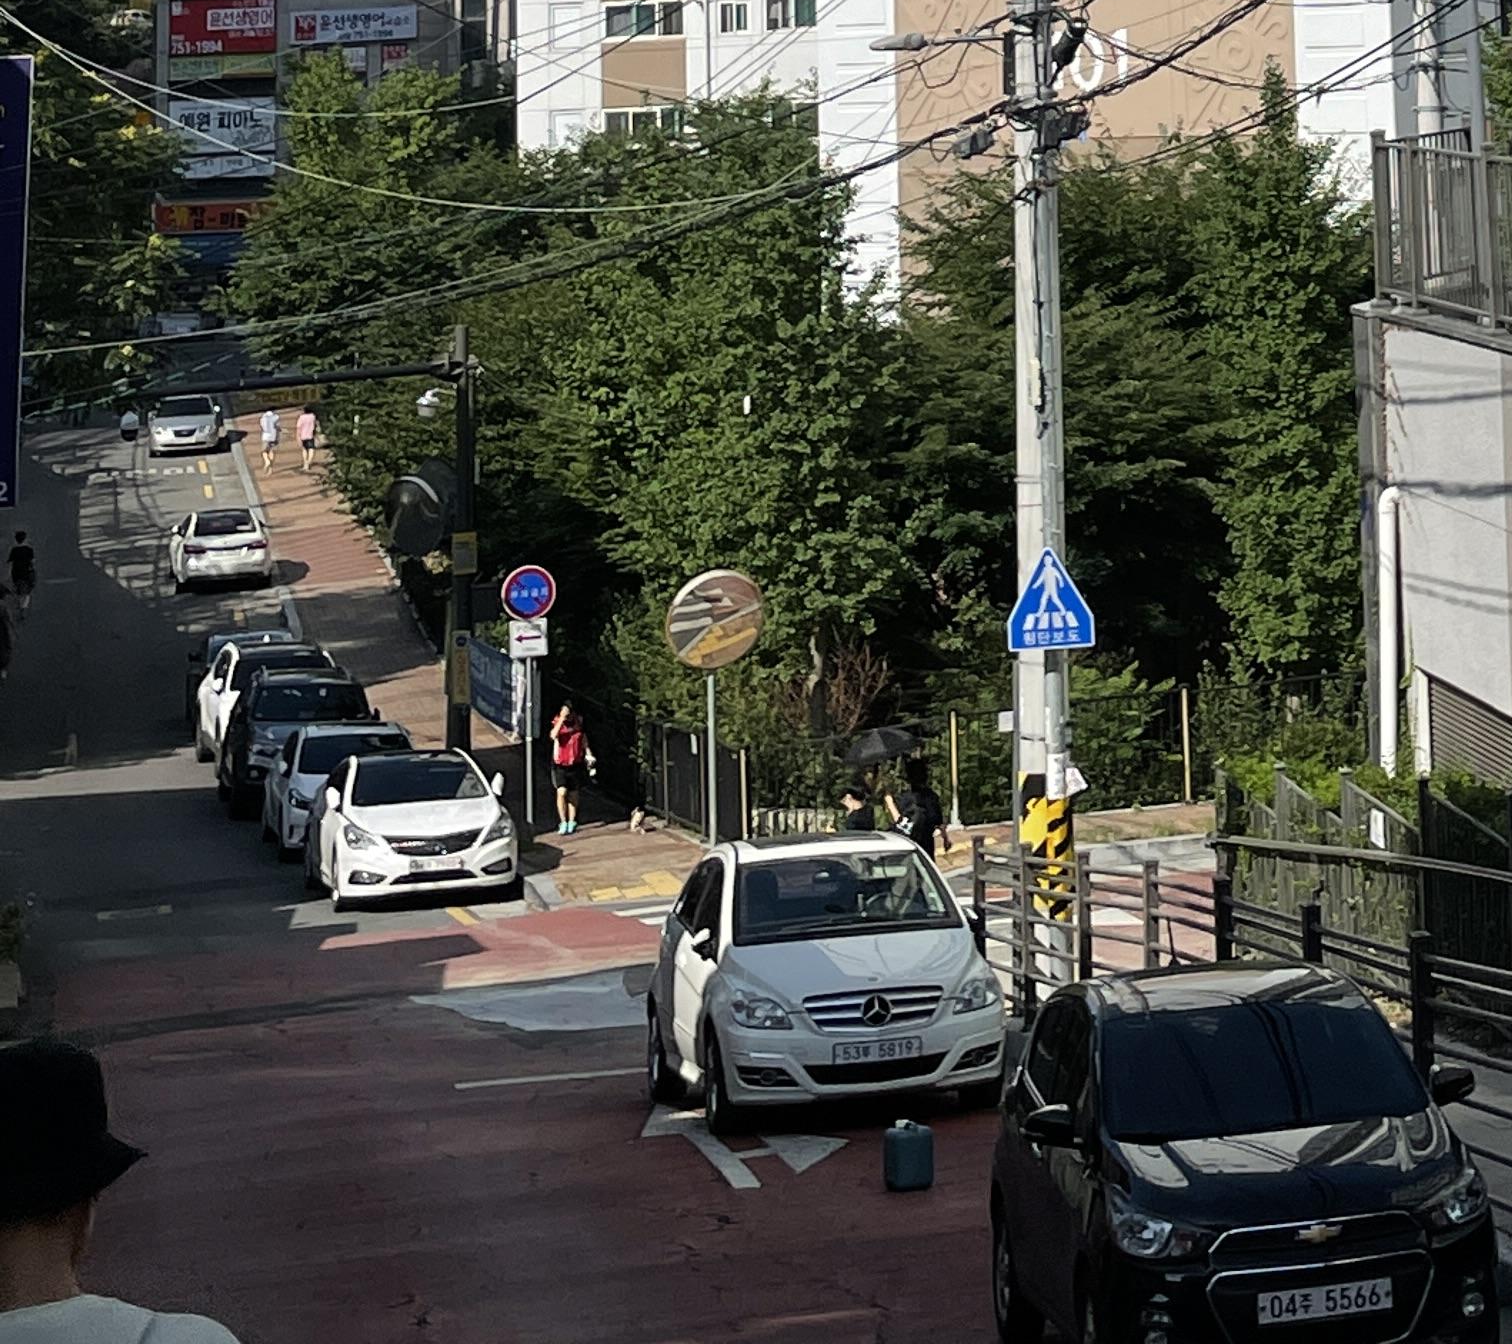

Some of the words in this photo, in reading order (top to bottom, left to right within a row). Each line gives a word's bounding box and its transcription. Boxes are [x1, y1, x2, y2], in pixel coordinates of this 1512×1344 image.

[1023, 629, 1080, 645] 횡단보도
[1270, 1293, 1313, 1318] 04주
[1325, 1284, 1381, 1312] 5566
